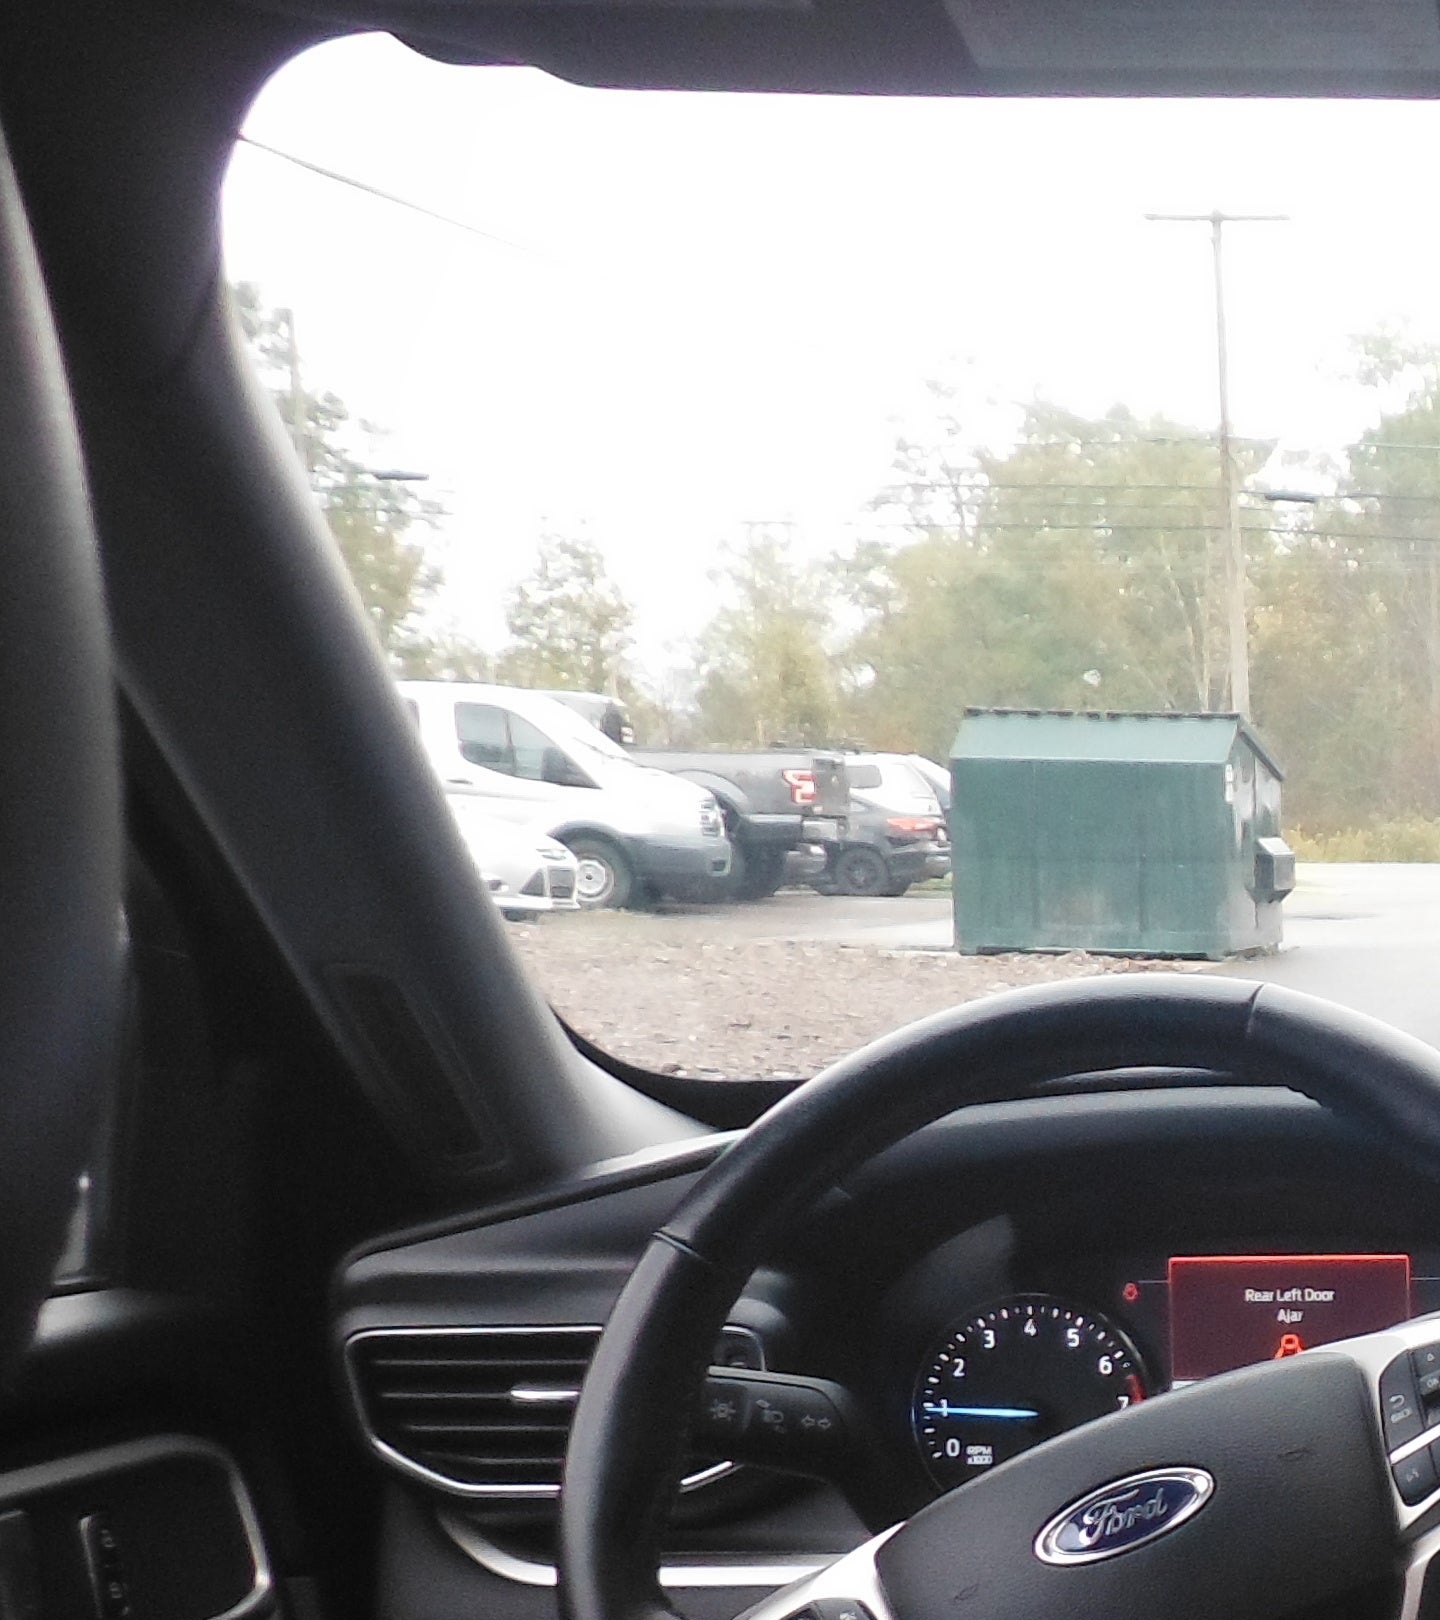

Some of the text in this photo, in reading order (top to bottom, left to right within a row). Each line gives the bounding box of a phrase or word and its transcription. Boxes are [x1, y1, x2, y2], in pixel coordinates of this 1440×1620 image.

[1244, 1287, 1335, 1302] Rear Left Door
[1276, 1308, 1304, 1324] Ajar
[1023, 1318, 1037, 1337] 4
[983, 1328, 996, 1349] 3
[1066, 1327, 1080, 1348] 5
[953, 1358, 965, 1377] 2
[1098, 1355, 1113, 1375] 6
[940, 1399, 949, 1417] 1
[1117, 1396, 1129, 1410] 7
[946, 1438, 960, 1457] 0
[966, 1445, 992, 1455] RPM
[1078, 1487, 1168, 1546] Ford
